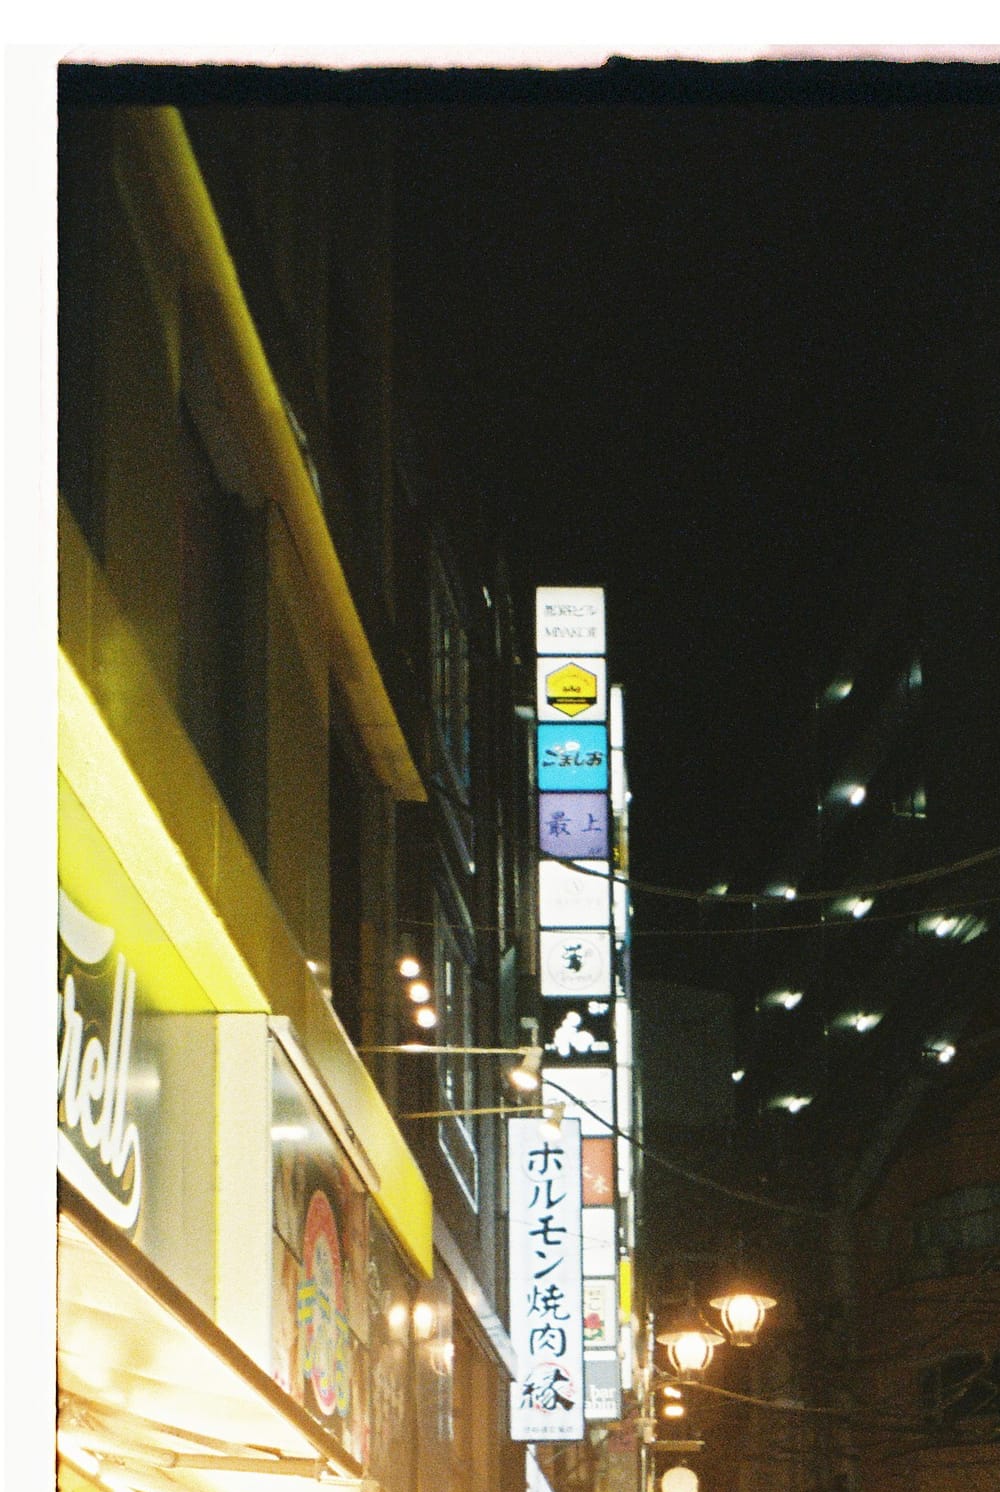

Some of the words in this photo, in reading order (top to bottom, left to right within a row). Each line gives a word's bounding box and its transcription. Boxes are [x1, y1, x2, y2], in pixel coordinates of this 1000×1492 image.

[542, 749, 603, 766] ごましお
[546, 810, 602, 837] 最上
